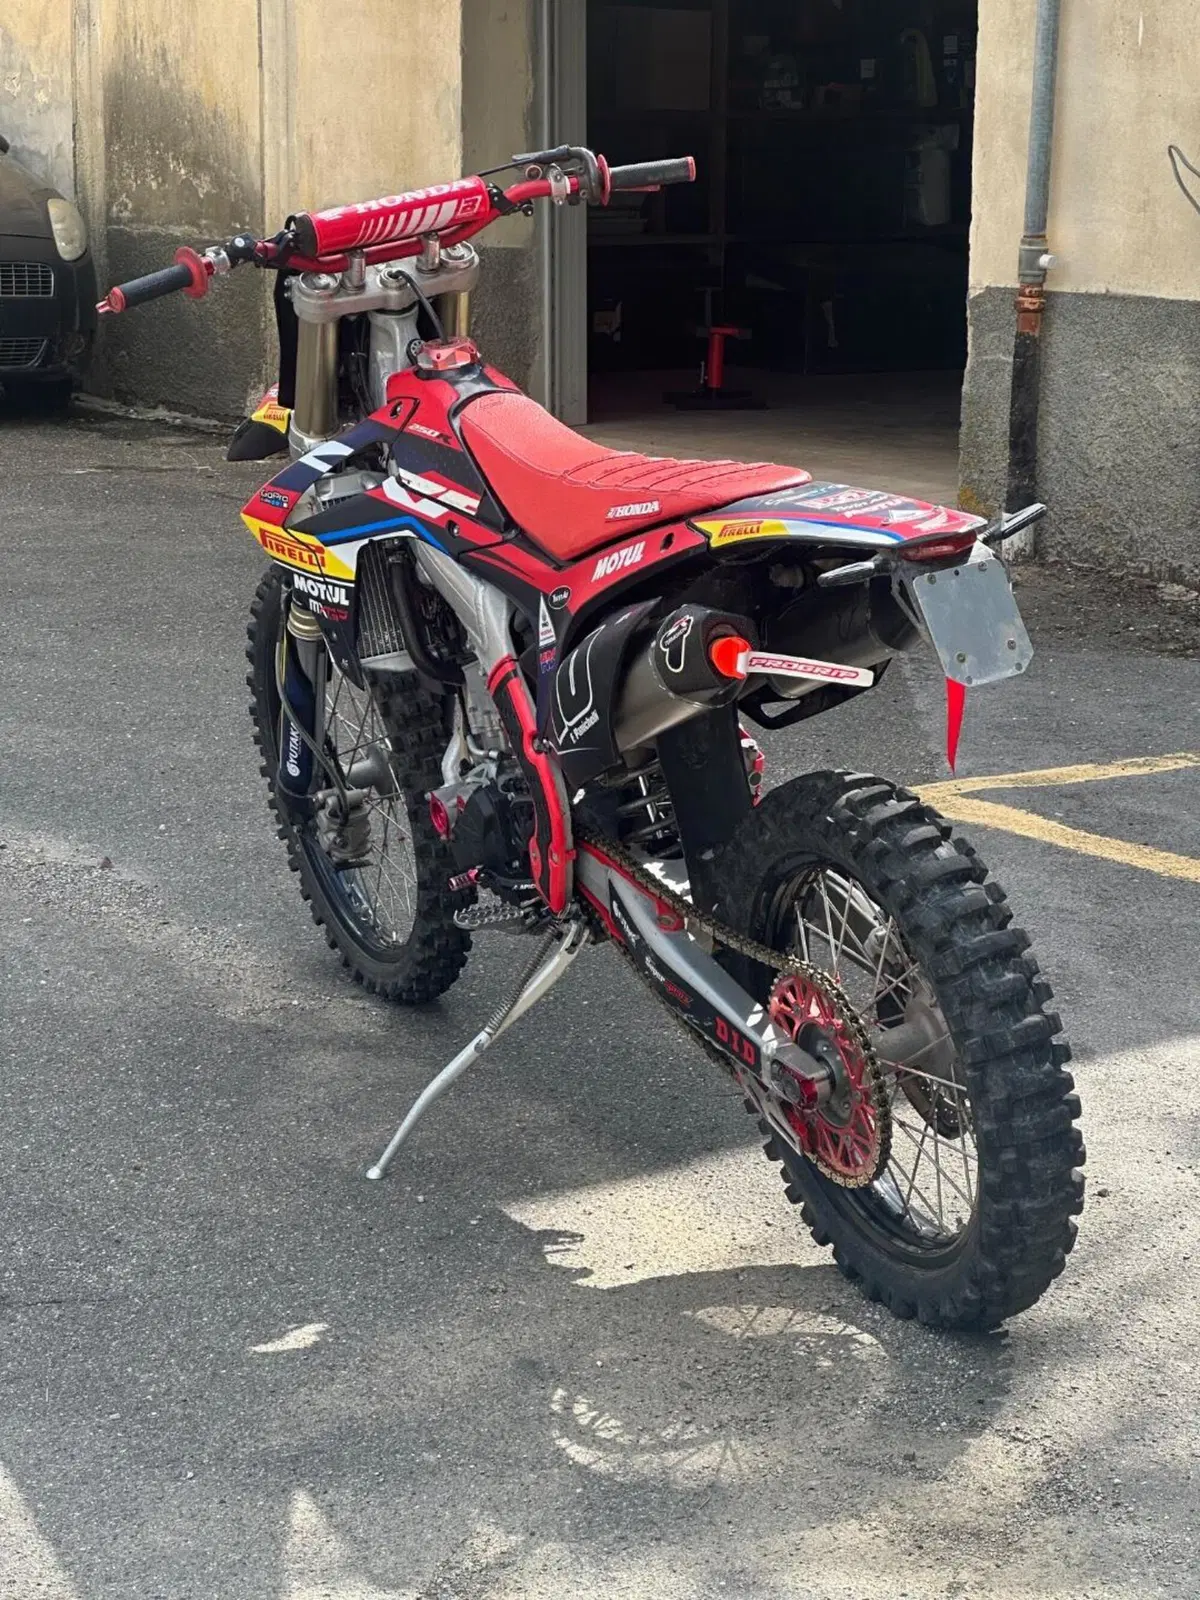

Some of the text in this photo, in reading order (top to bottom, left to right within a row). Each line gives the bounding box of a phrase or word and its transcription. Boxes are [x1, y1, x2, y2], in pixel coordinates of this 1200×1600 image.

[351, 179, 476, 213] HONDA
[261, 489, 288, 502] GoPro
[614, 500, 660, 518] HONDA
[719, 520, 763, 538] PIRELLI
[259, 528, 326, 569] PIRELLI
[591, 541, 646, 582] MOTUL
[293, 574, 349, 606] MOTUL
[749, 657, 859, 680] PROGRIP
